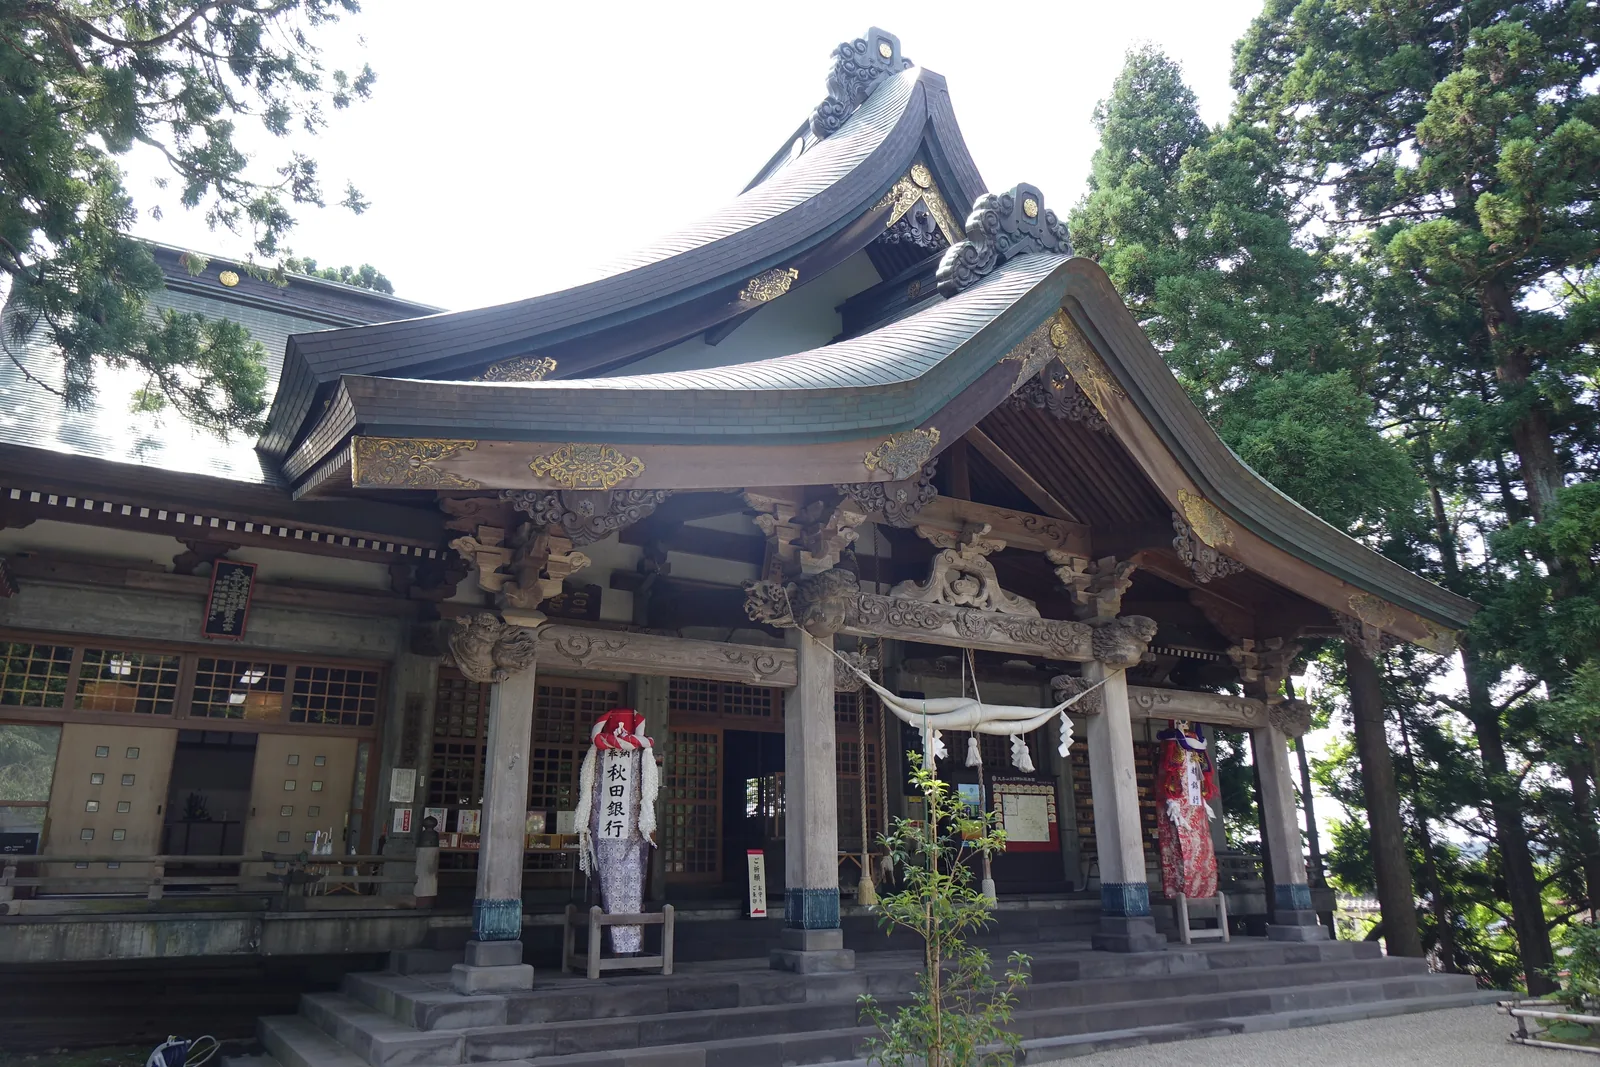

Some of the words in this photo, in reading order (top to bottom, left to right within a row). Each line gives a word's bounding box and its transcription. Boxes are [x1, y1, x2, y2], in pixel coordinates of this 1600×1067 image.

[604, 763, 627, 838] 秋田銀行
[753, 857, 761, 881] ご祈願
